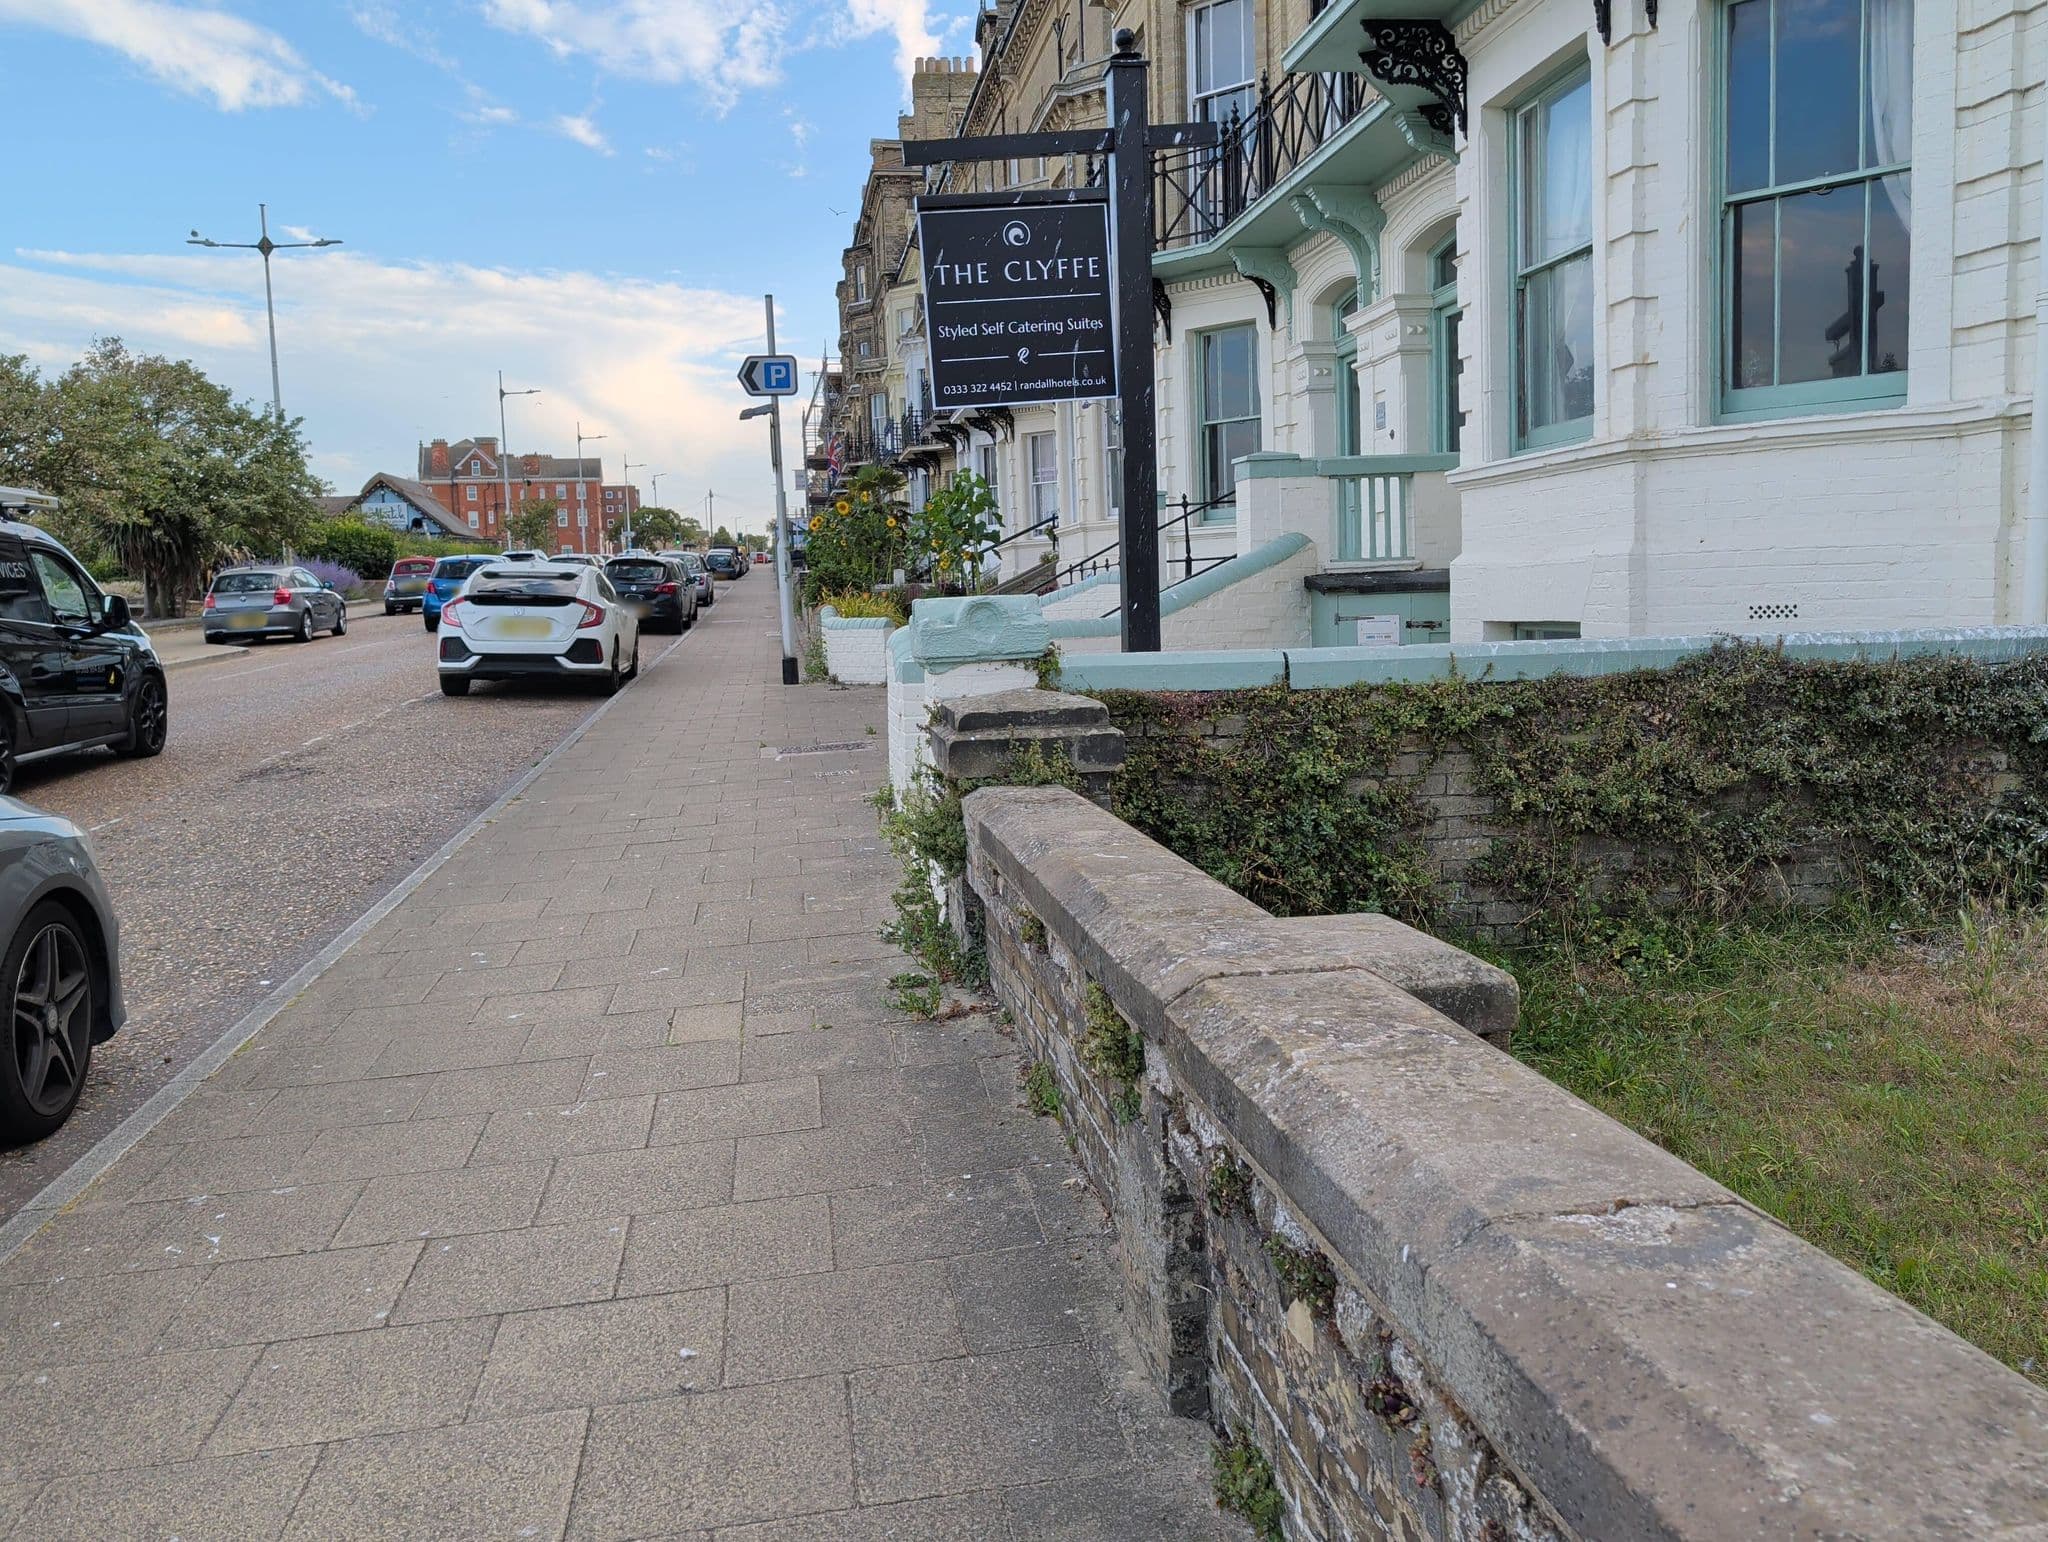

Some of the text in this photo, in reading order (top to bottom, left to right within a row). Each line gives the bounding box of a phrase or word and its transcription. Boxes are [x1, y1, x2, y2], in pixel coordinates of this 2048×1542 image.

[934, 257, 1100, 285] THE CLYFFE
[938, 318, 1103, 340] Styled Self Catering Suites
[1017, 347, 1030, 365] R
[770, 365, 786, 387] P
[943, 376, 1106, 395] 0333 322 4452 randallhotels.co.uk
